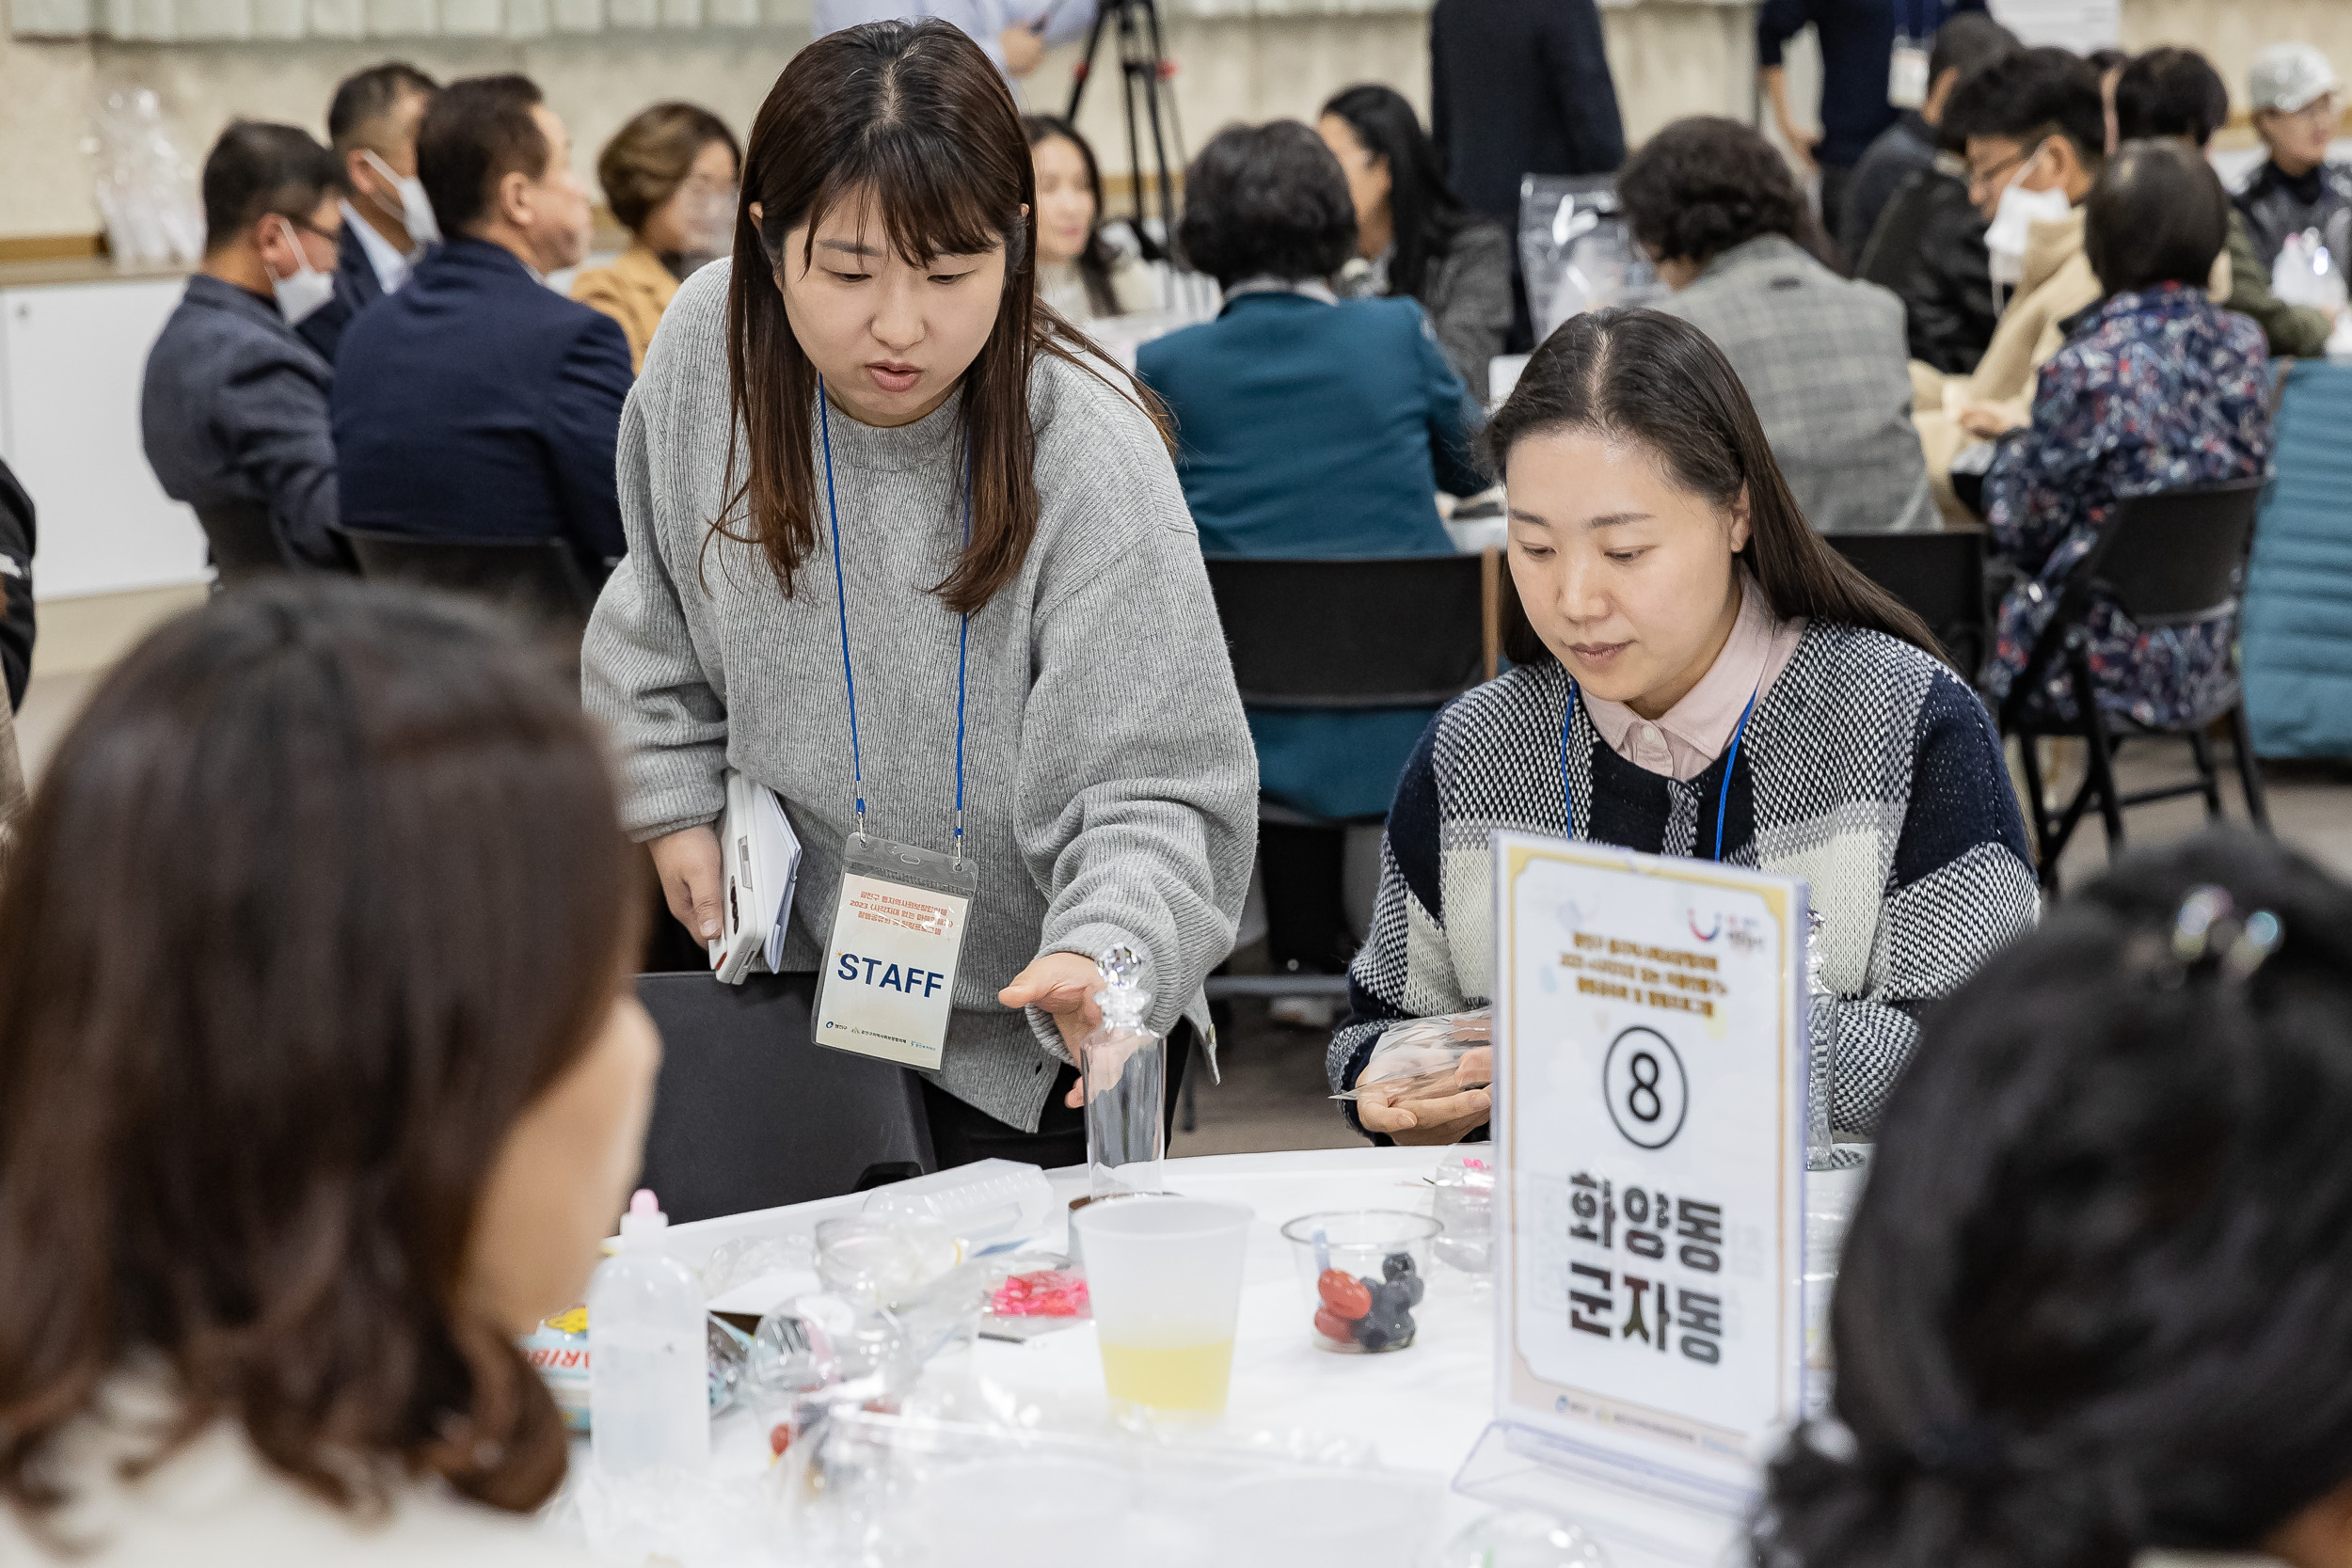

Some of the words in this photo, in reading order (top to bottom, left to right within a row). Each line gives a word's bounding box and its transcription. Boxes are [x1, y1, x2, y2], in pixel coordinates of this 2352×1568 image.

[850, 899, 868, 910] 2023
[837, 953, 945, 998] STAFF
[1568, 1172, 1723, 1275] 화양동
[1568, 1261, 1723, 1367] 군자동
